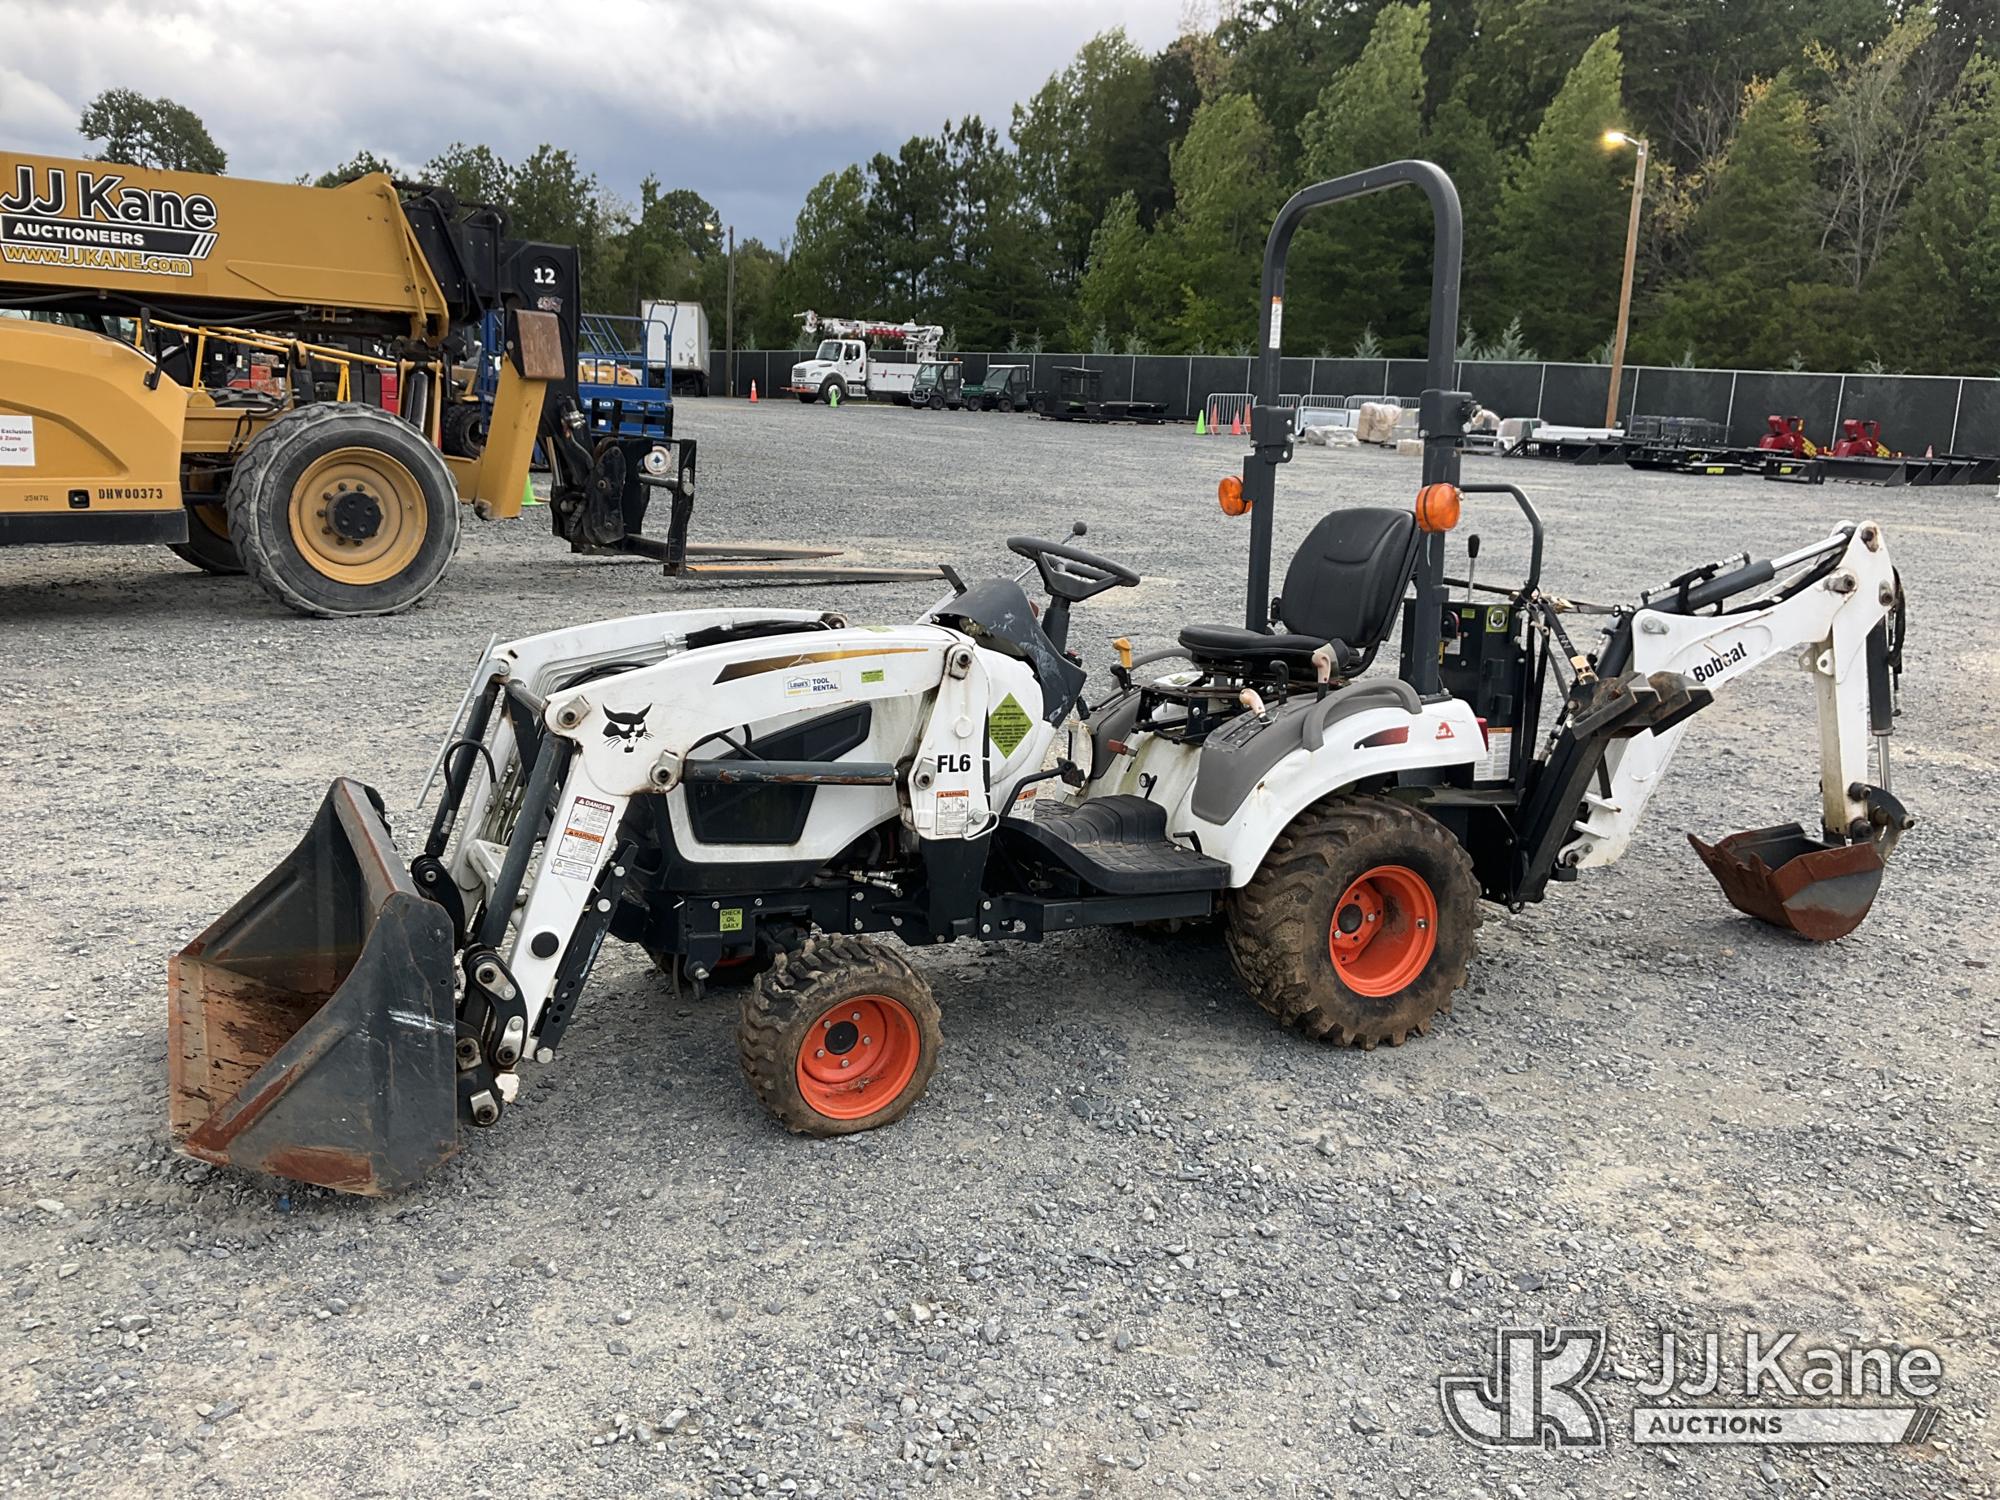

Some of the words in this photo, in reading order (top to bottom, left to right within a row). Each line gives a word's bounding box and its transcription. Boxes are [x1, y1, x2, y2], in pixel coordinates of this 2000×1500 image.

[0, 165, 66, 216] JJ
[77, 171, 218, 230] Kane
[13, 222, 145, 246] AUCTIONEERS
[5, 246, 190, 274] www.JJKANE.com
[534, 267, 556, 284] 12
[98, 488, 163, 500] DHW00373
[1692, 641, 1747, 682] Bobcat
[812, 677, 830, 685] TOOL
[812, 684, 839, 692] RENTAL
[937, 754, 971, 773] FL6
[585, 800, 611, 811] DANGER
